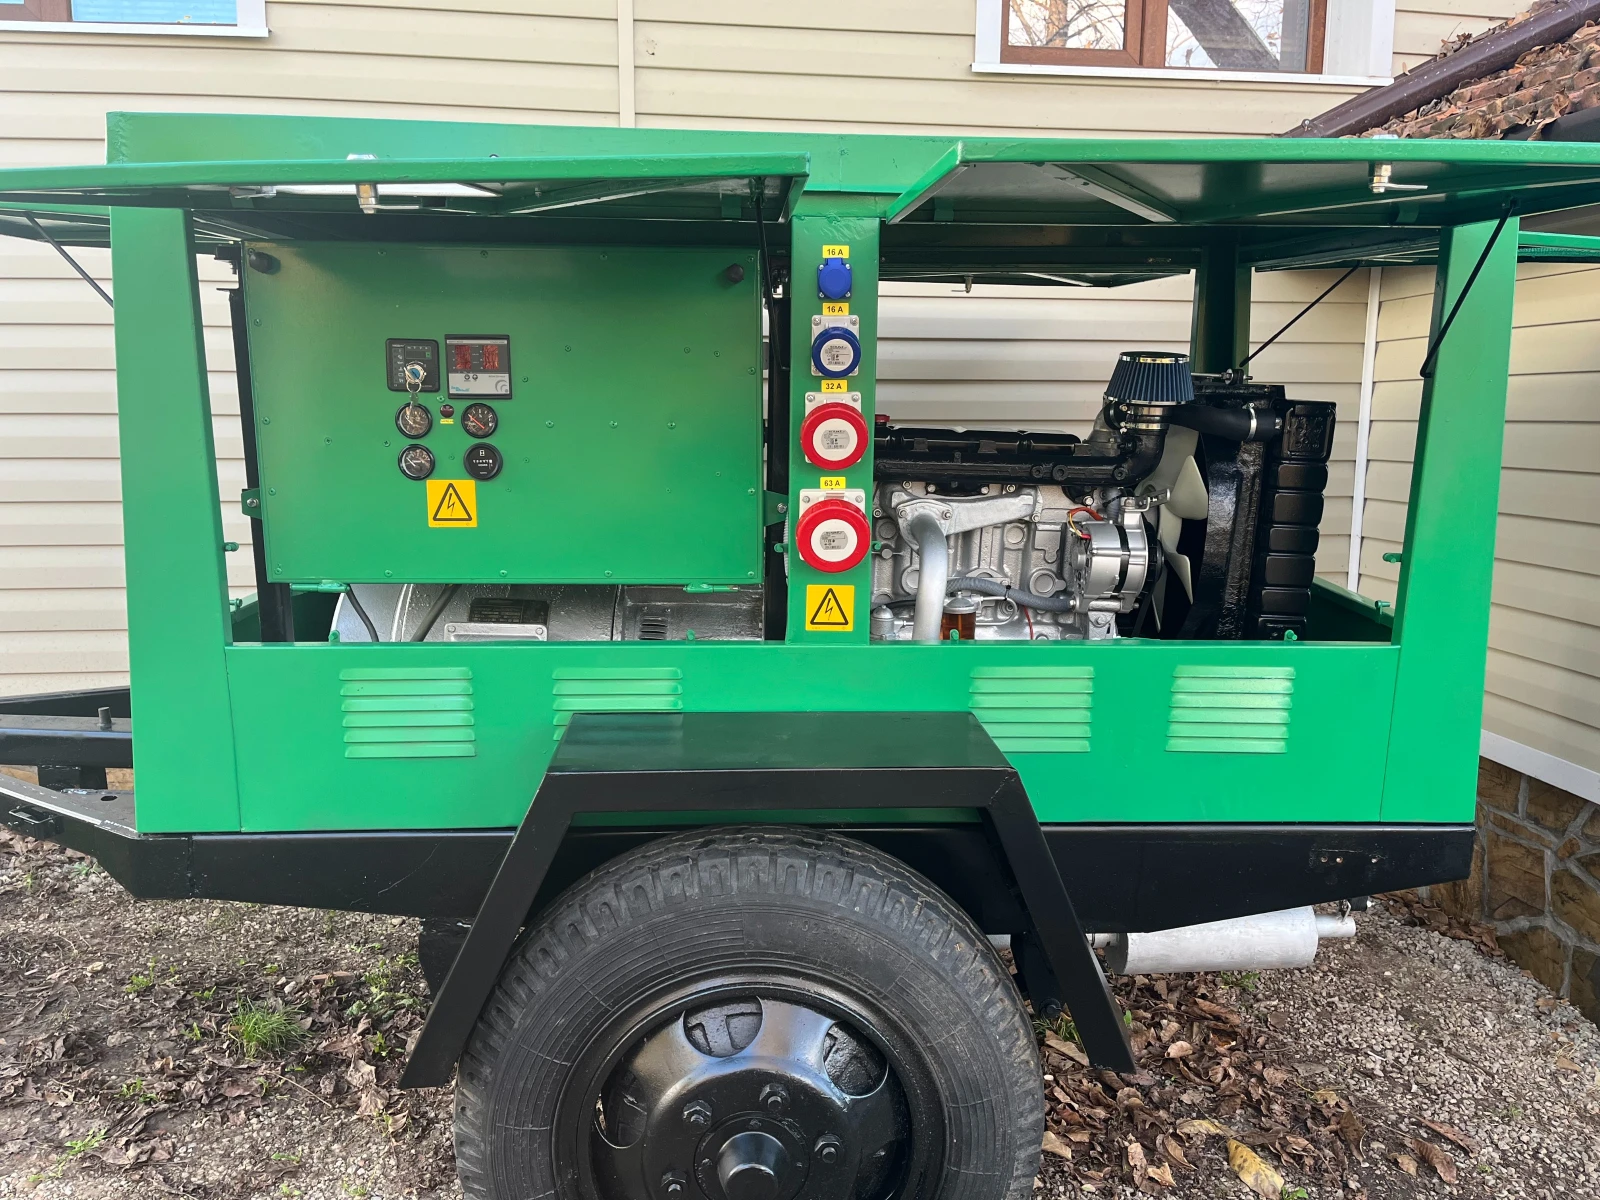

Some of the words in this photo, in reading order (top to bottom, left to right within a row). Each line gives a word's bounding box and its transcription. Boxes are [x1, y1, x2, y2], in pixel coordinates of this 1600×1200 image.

[826, 248, 836, 256] 16
[837, 248, 844, 256] A
[826, 305, 836, 313] 16
[837, 305, 844, 313] A
[825, 382, 835, 390] 32
[835, 382, 842, 390] A
[824, 479, 834, 487] 63
[834, 479, 841, 487] A
